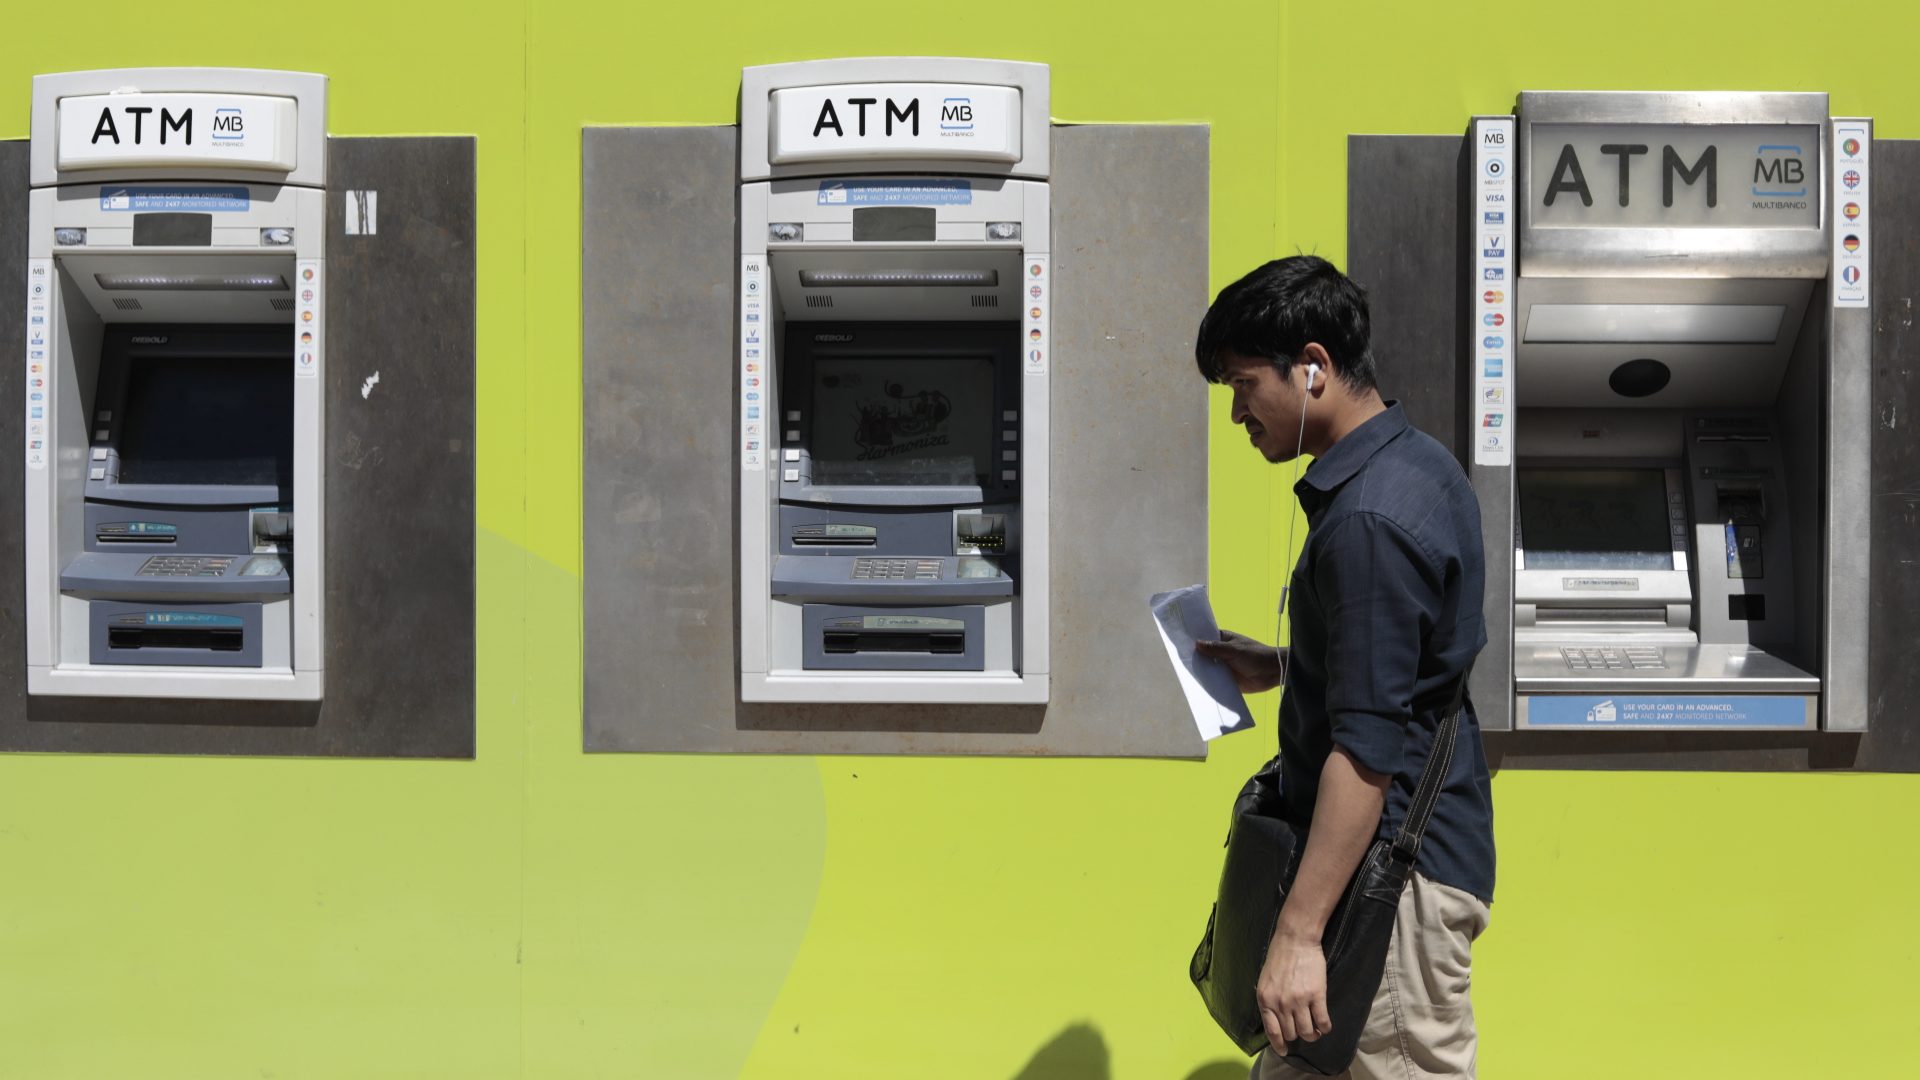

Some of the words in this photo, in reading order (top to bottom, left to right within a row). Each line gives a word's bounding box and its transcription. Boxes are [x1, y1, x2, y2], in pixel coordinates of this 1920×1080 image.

[813, 98, 919, 137] ATM
[941, 105, 973, 122] MB
[91, 107, 193, 145] ATM
[213, 116, 243, 132] MB
[1484, 133, 1505, 144] MB
[1543, 143, 1717, 208] ATM
[1753, 158, 1805, 184] MB
[1486, 194, 1504, 202] VISA
[1752, 201, 1807, 210] MULTIBANCO
[746, 264, 759, 272] MB
[856, 433, 950, 461] Harmoniza
